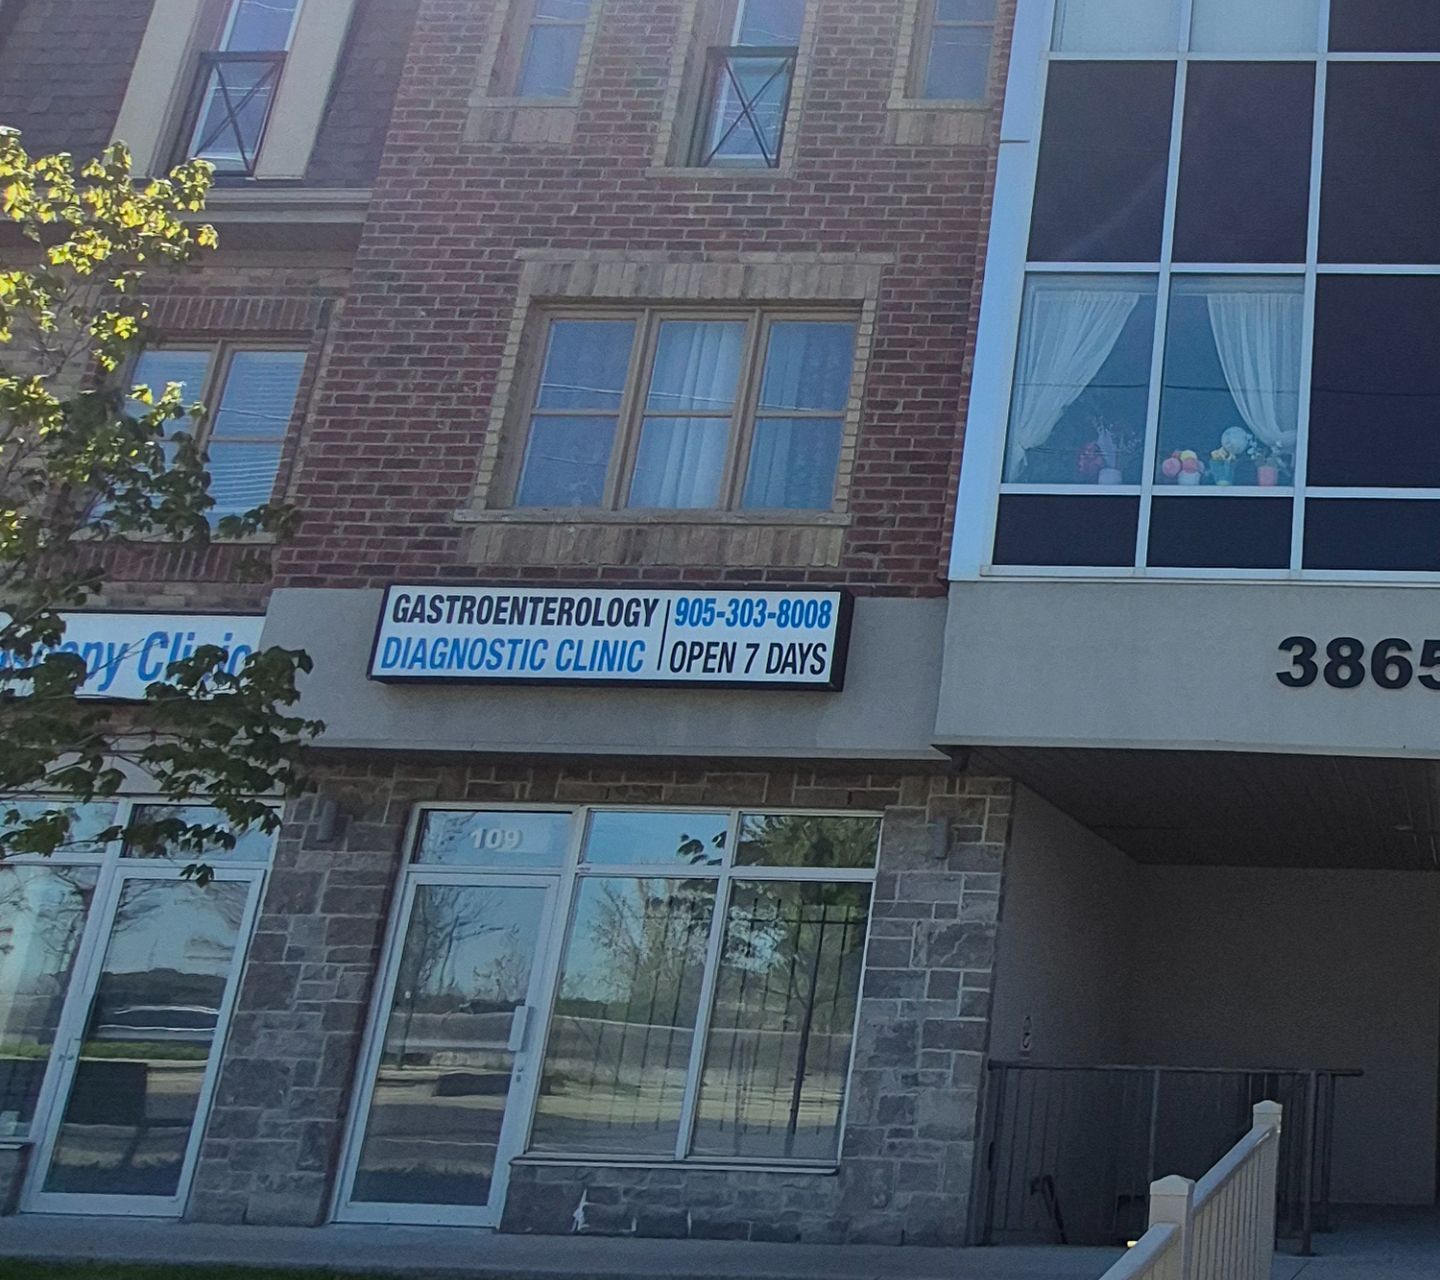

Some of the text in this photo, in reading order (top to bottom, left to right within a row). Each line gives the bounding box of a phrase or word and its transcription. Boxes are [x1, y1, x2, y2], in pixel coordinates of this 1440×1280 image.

[393, 593, 659, 628] GASTROENTEROLOGY
[674, 597, 832, 629] 905-303-8008
[138, 631, 252, 682] Cliic
[381, 636, 646, 673] DIAGNOSTIC CLINIC
[669, 640, 827, 676] OPEN 7 DAYS
[470, 827, 523, 850] 109
